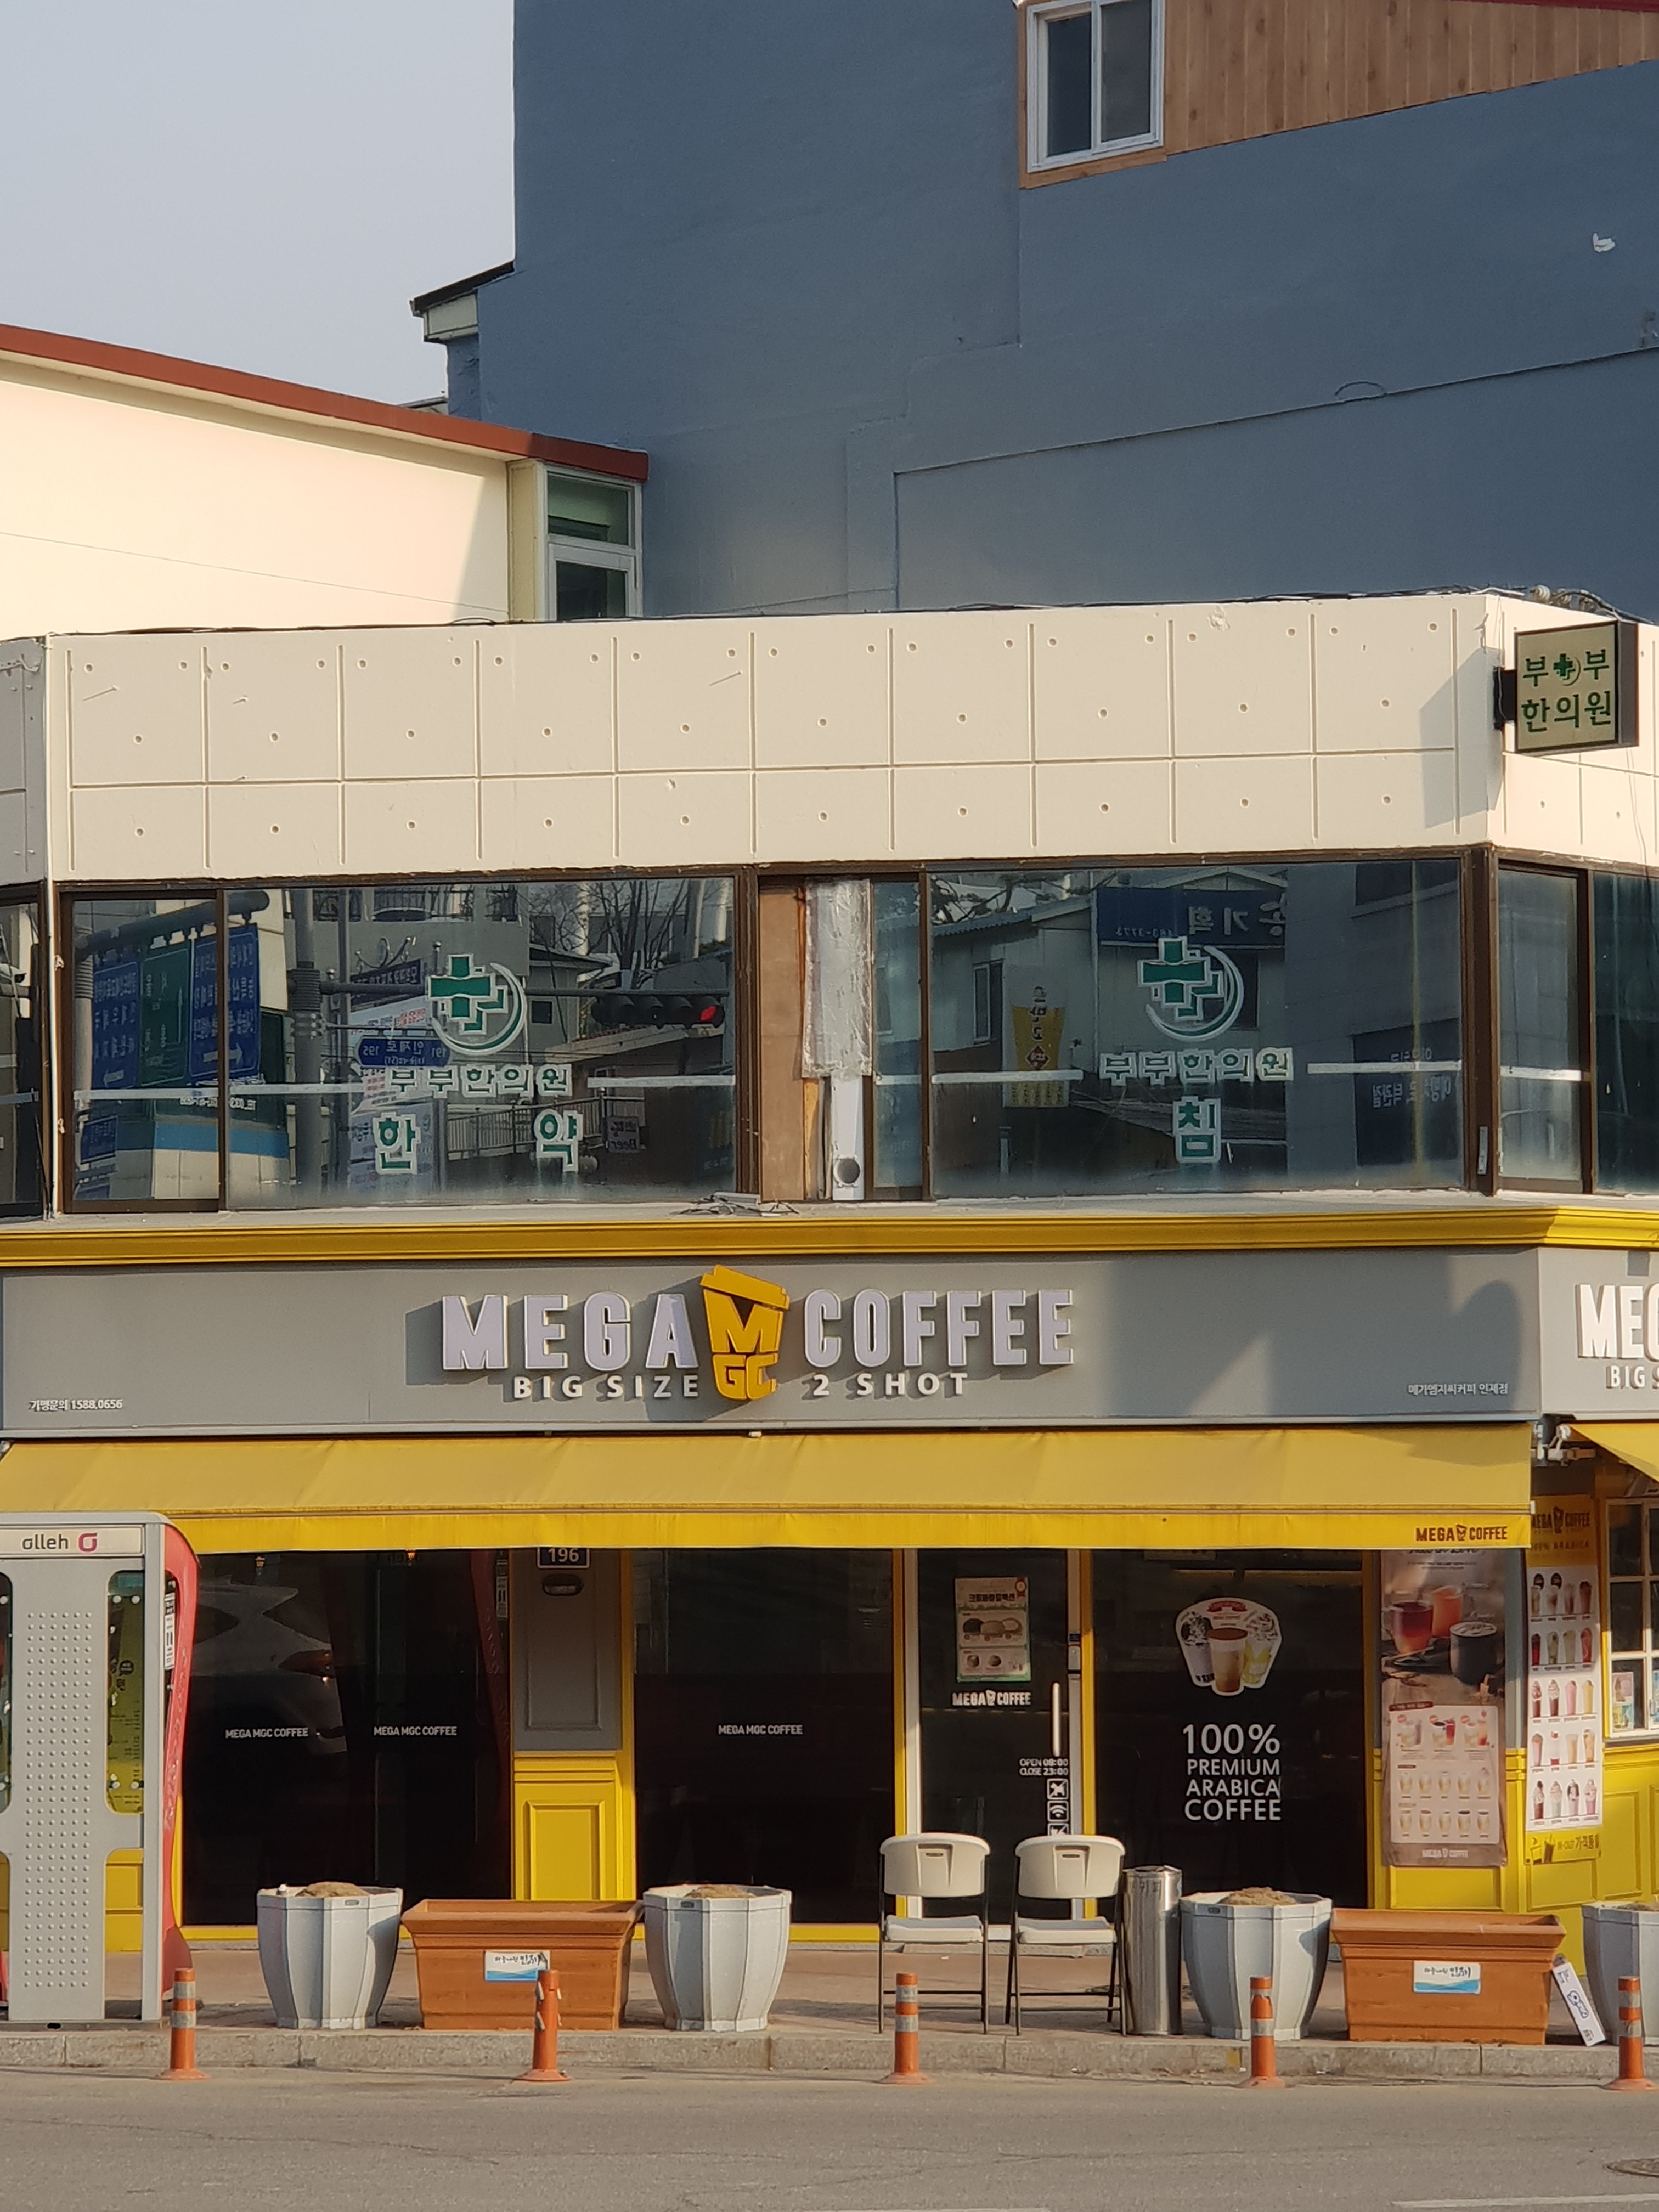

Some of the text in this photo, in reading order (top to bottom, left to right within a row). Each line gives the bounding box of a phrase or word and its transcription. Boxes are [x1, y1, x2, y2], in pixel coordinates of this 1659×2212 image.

[1521, 691, 1611, 733] 한의원
[1099, 1047, 1294, 1086] 부부한의원
[389, 1064, 572, 1098] 부부한의원
[1173, 1096, 1221, 1163] 침
[374, 1109, 583, 1174] 한 약
[442, 1291, 699, 1371] MEGA
[804, 1289, 1075, 1367] COFFEE
[1610, 1365, 1645, 1388] BIG
[514, 1375, 583, 1398] BIG
[607, 1374, 699, 1397] SIZE
[812, 1373, 830, 1396] 2
[857, 1373, 968, 1396] SHOT
[1408, 1383, 1509, 1396] 메가엠지씨커피 인제점
[30, 1398, 123, 1412] 가맹문의 1588.0656
[22, 1533, 69, 1550] olleh
[1415, 1527, 1454, 1542] MEGA
[1469, 1526, 1508, 1541] COFFEE
[548, 1548, 579, 1562] 196
[952, 1692, 1031, 1706] MEGA COFFEE
[225, 1727, 309, 1739] MEGA MGC COFFEE
[374, 1726, 458, 1736] MEGA MGC COFFEE
[718, 1725, 744, 1735] MEGA
[768, 1725, 803, 1735] COFFEE
[1183, 1724, 1280, 1755] 100%
[1019, 1758, 1042, 1767] OPEN
[1187, 1759, 1280, 1775] PREMIUM
[1019, 1768, 1069, 1776] CLOSE 23:00
[1186, 1779, 1280, 1796] ARABICA
[1184, 1799, 1282, 1820] COFFEE
